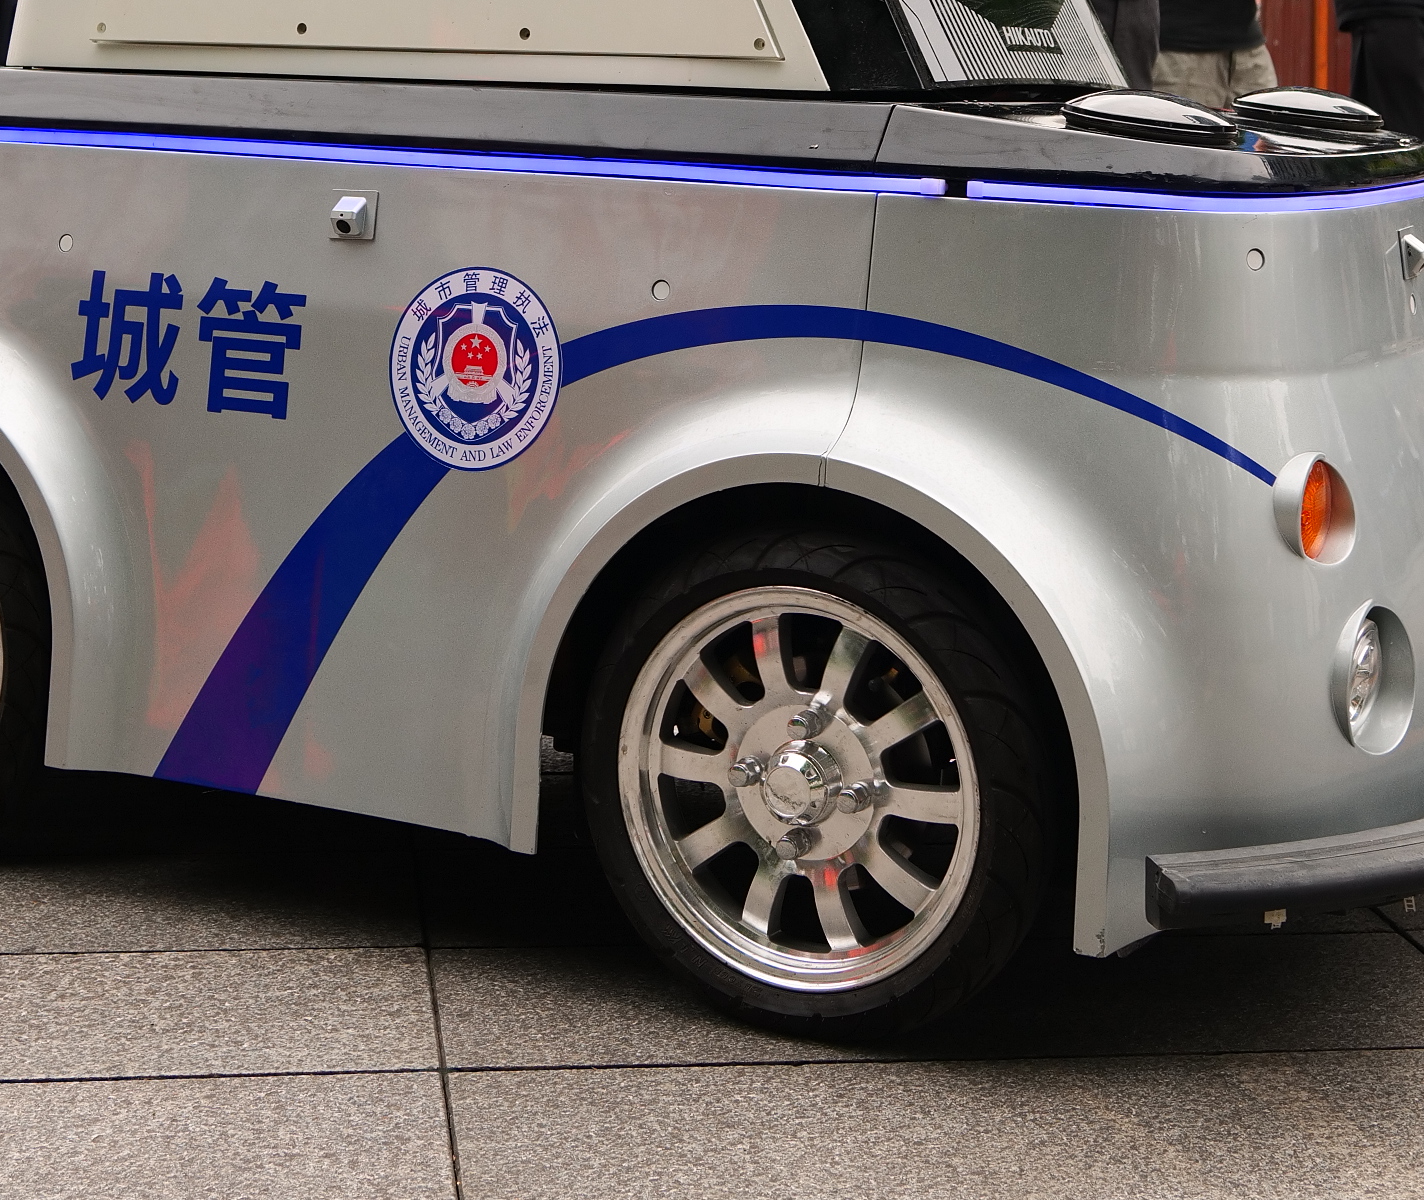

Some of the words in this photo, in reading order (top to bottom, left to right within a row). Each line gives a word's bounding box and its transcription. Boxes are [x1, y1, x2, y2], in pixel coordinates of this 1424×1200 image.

[1002, 26, 1054, 48] HIKAUTO
[411, 271, 550, 338] 城市管理执法
[71, 270, 307, 420] 城管
[396, 335, 411, 381] URBAN
[517, 345, 554, 443] ENFORCEMENT
[398, 386, 458, 459] MANAGEMENT
[491, 438, 515, 459] LAW
[460, 449, 486, 462] AND
